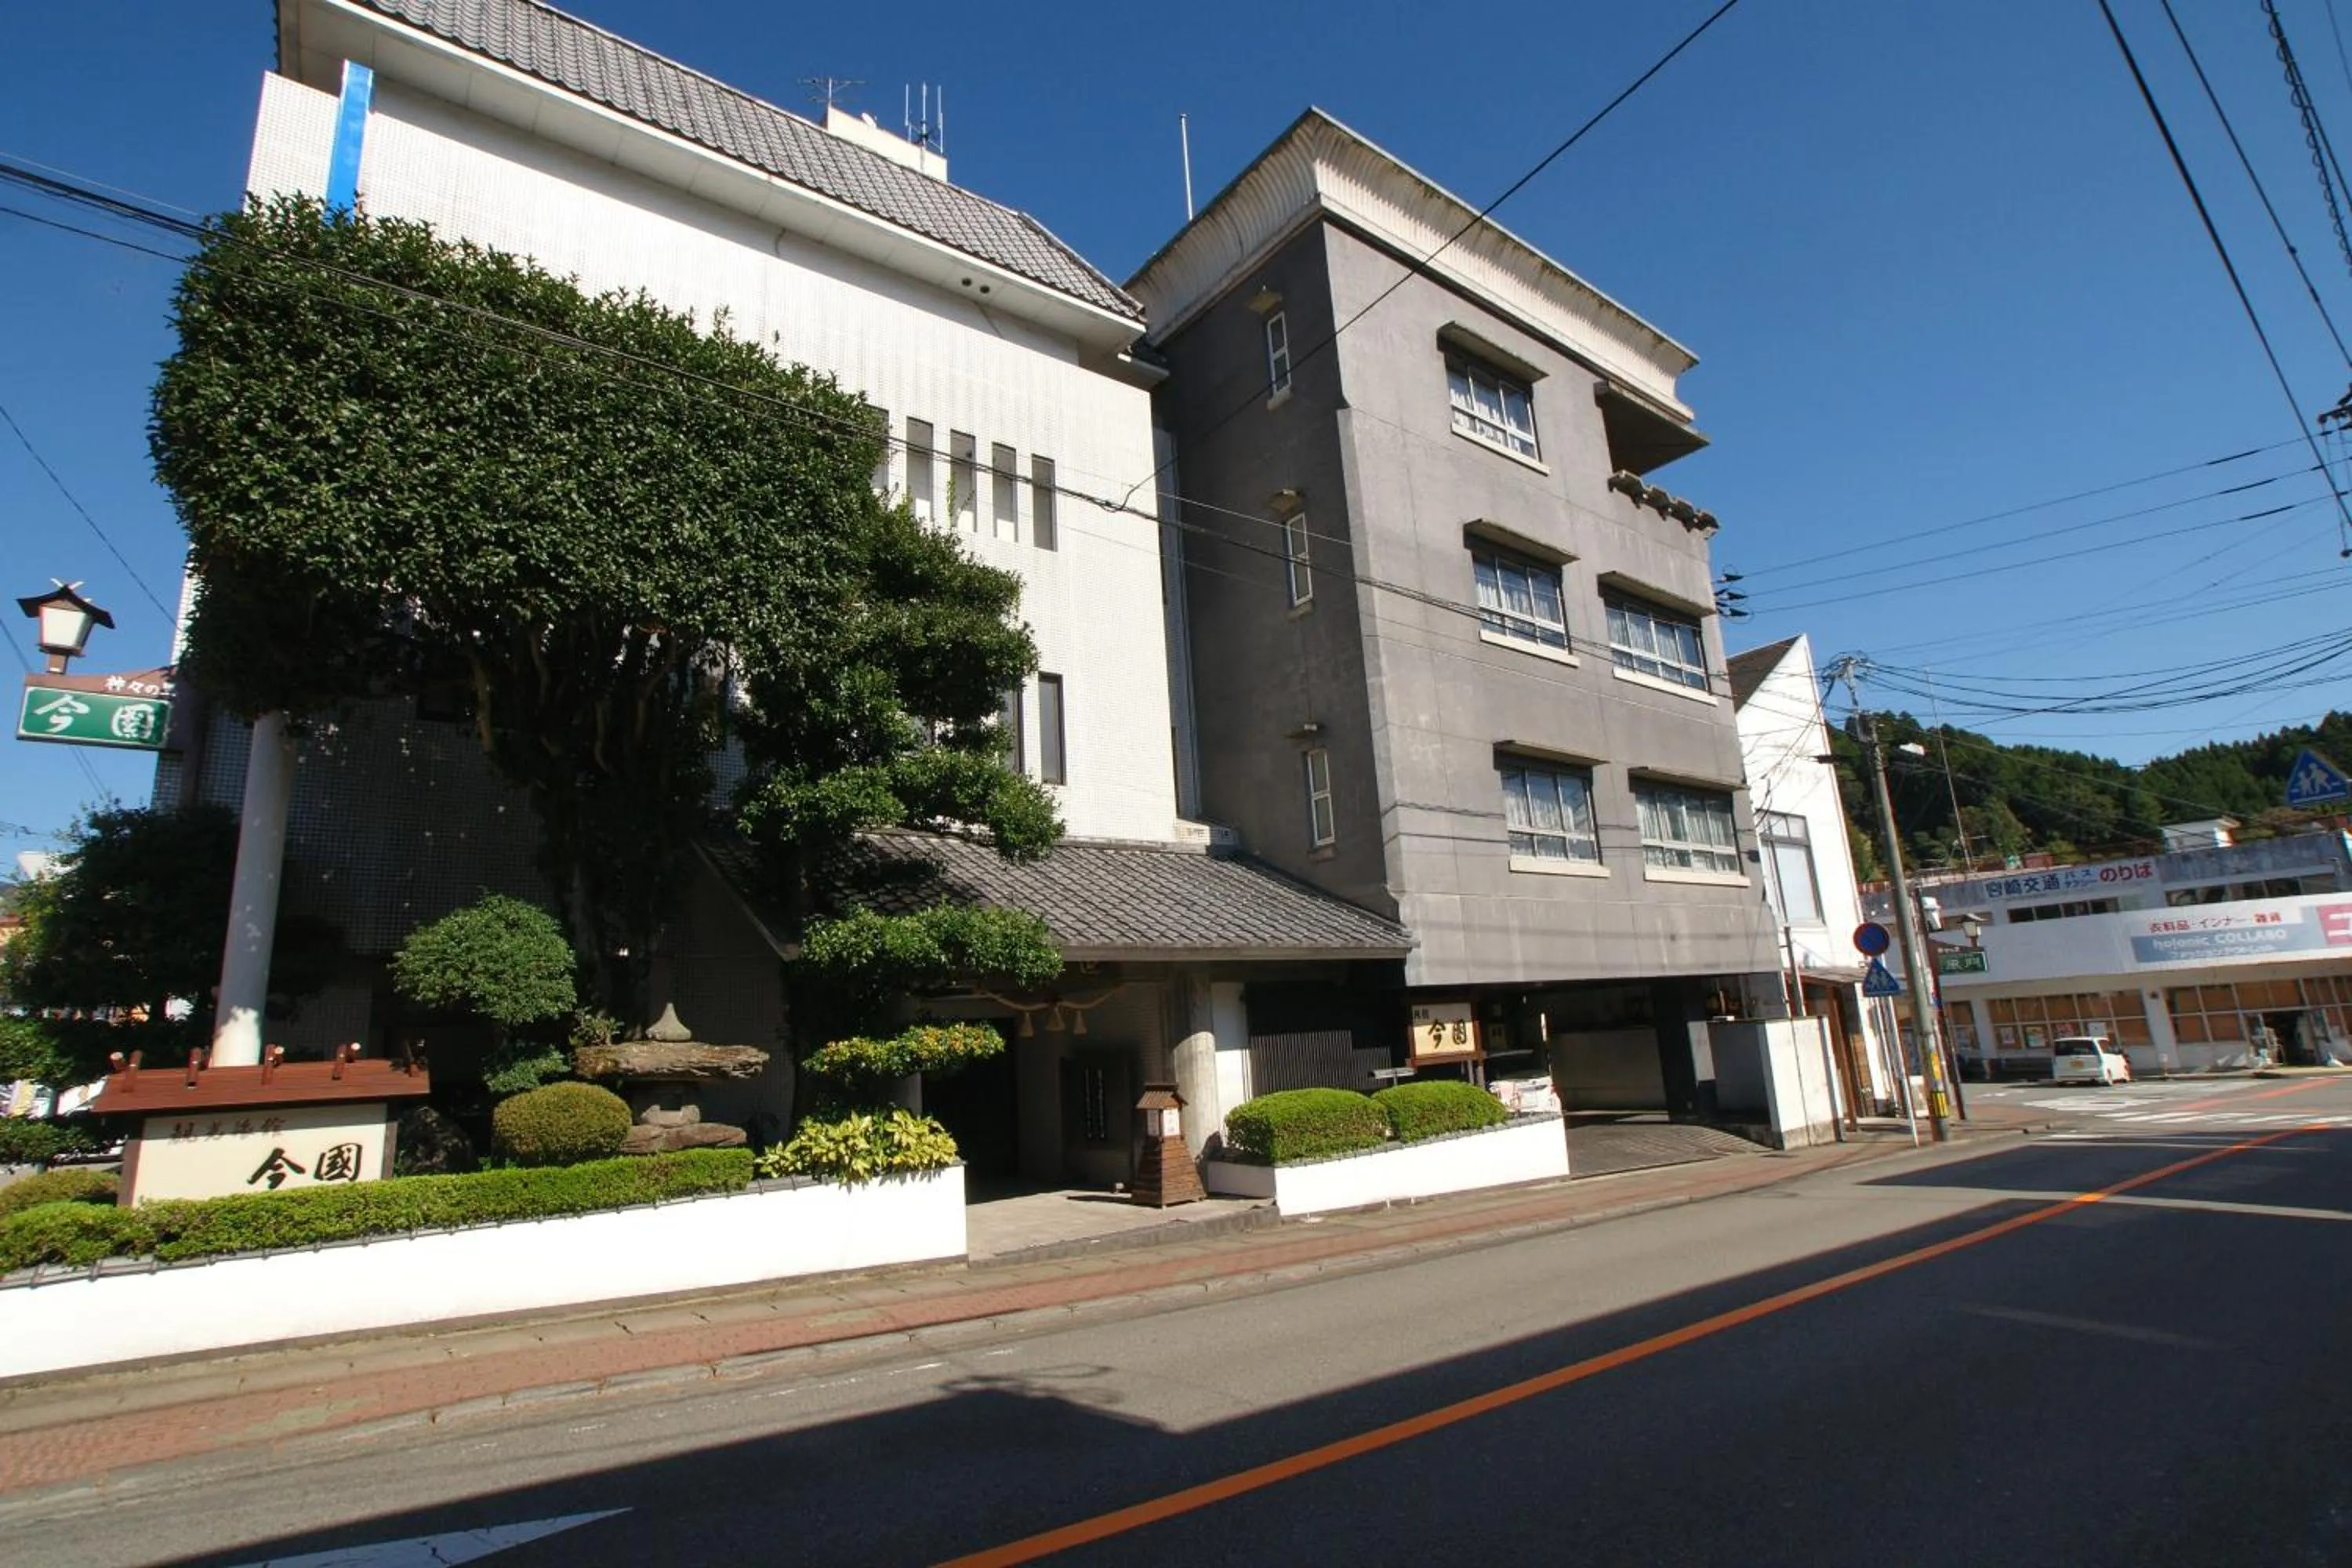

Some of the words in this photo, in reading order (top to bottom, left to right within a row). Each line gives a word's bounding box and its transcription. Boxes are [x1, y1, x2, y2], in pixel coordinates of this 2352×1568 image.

[1986, 873, 2060, 898] 宮崎交通
[2100, 863, 2154, 882] のりば
